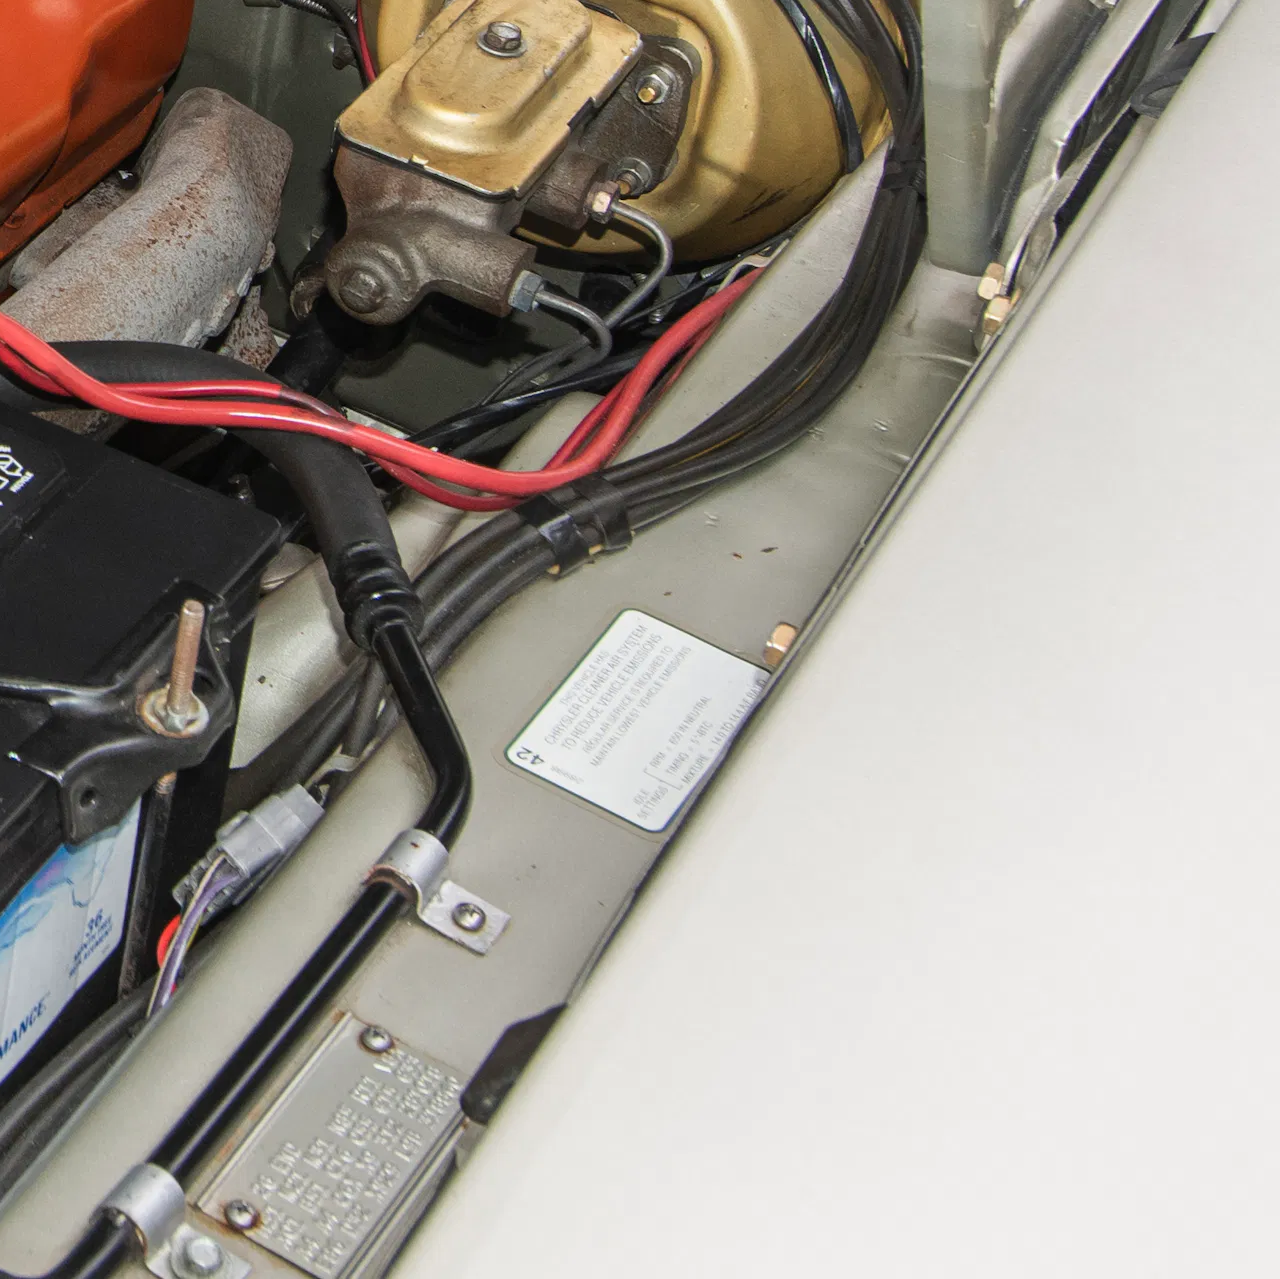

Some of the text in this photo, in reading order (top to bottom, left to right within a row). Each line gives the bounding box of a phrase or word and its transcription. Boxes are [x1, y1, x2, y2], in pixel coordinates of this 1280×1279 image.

[570, 662, 599, 692] VEHICLE
[591, 647, 611, 665] HAS
[620, 631, 664, 676] EMISSIONS
[542, 701, 586, 746] CHRYSLER
[576, 666, 613, 705] CLEANER
[604, 653, 624, 670] AIR
[615, 623, 650, 657] SYSTEM
[579, 643, 675, 755] REGULAR SERVICE IS REQUIRED TO
[594, 671, 631, 709] VEHICLE
[568, 704, 604, 740] REDUCE
[587, 644, 694, 768] MAINTAIN LOWEST VEHICLE EMISSIONS
[559, 735, 578, 751] TO
[647, 750, 668, 769] RPM
[680, 693, 714, 726] NEUTRAL
[512, 744, 547, 769] 42
[663, 750, 691, 777] TIMING
[679, 753, 711, 785] MIXTURE
[629, 786, 651, 806] IDLE
[634, 784, 671, 821] SETTINGS
[86, 909, 104, 934] 36
